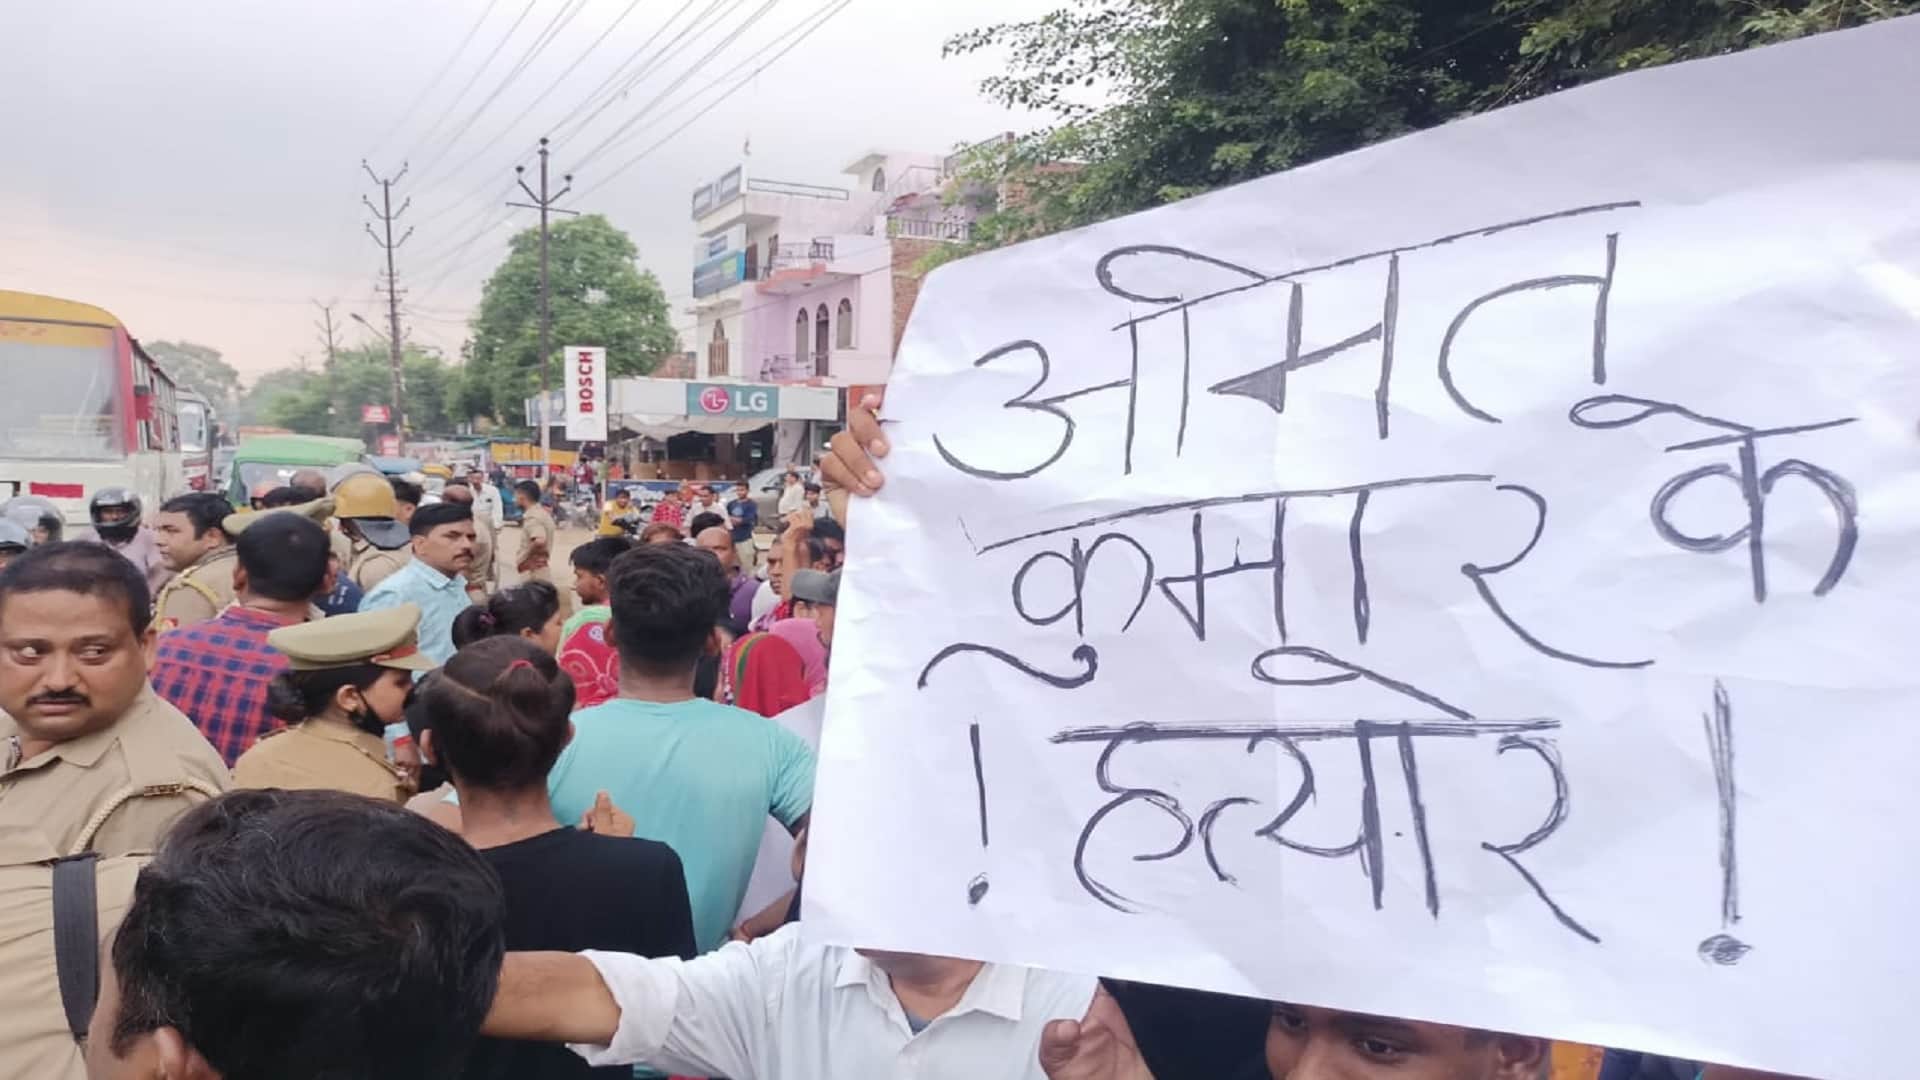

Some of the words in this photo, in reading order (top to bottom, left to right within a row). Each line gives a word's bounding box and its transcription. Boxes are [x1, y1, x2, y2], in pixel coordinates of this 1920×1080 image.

[579, 352, 593, 412] BOSCH
[735, 391, 767, 411] LG
[933, 200, 1640, 481] अमित
[917, 475, 1655, 688] कुमार
[1569, 395, 1857, 602] के
